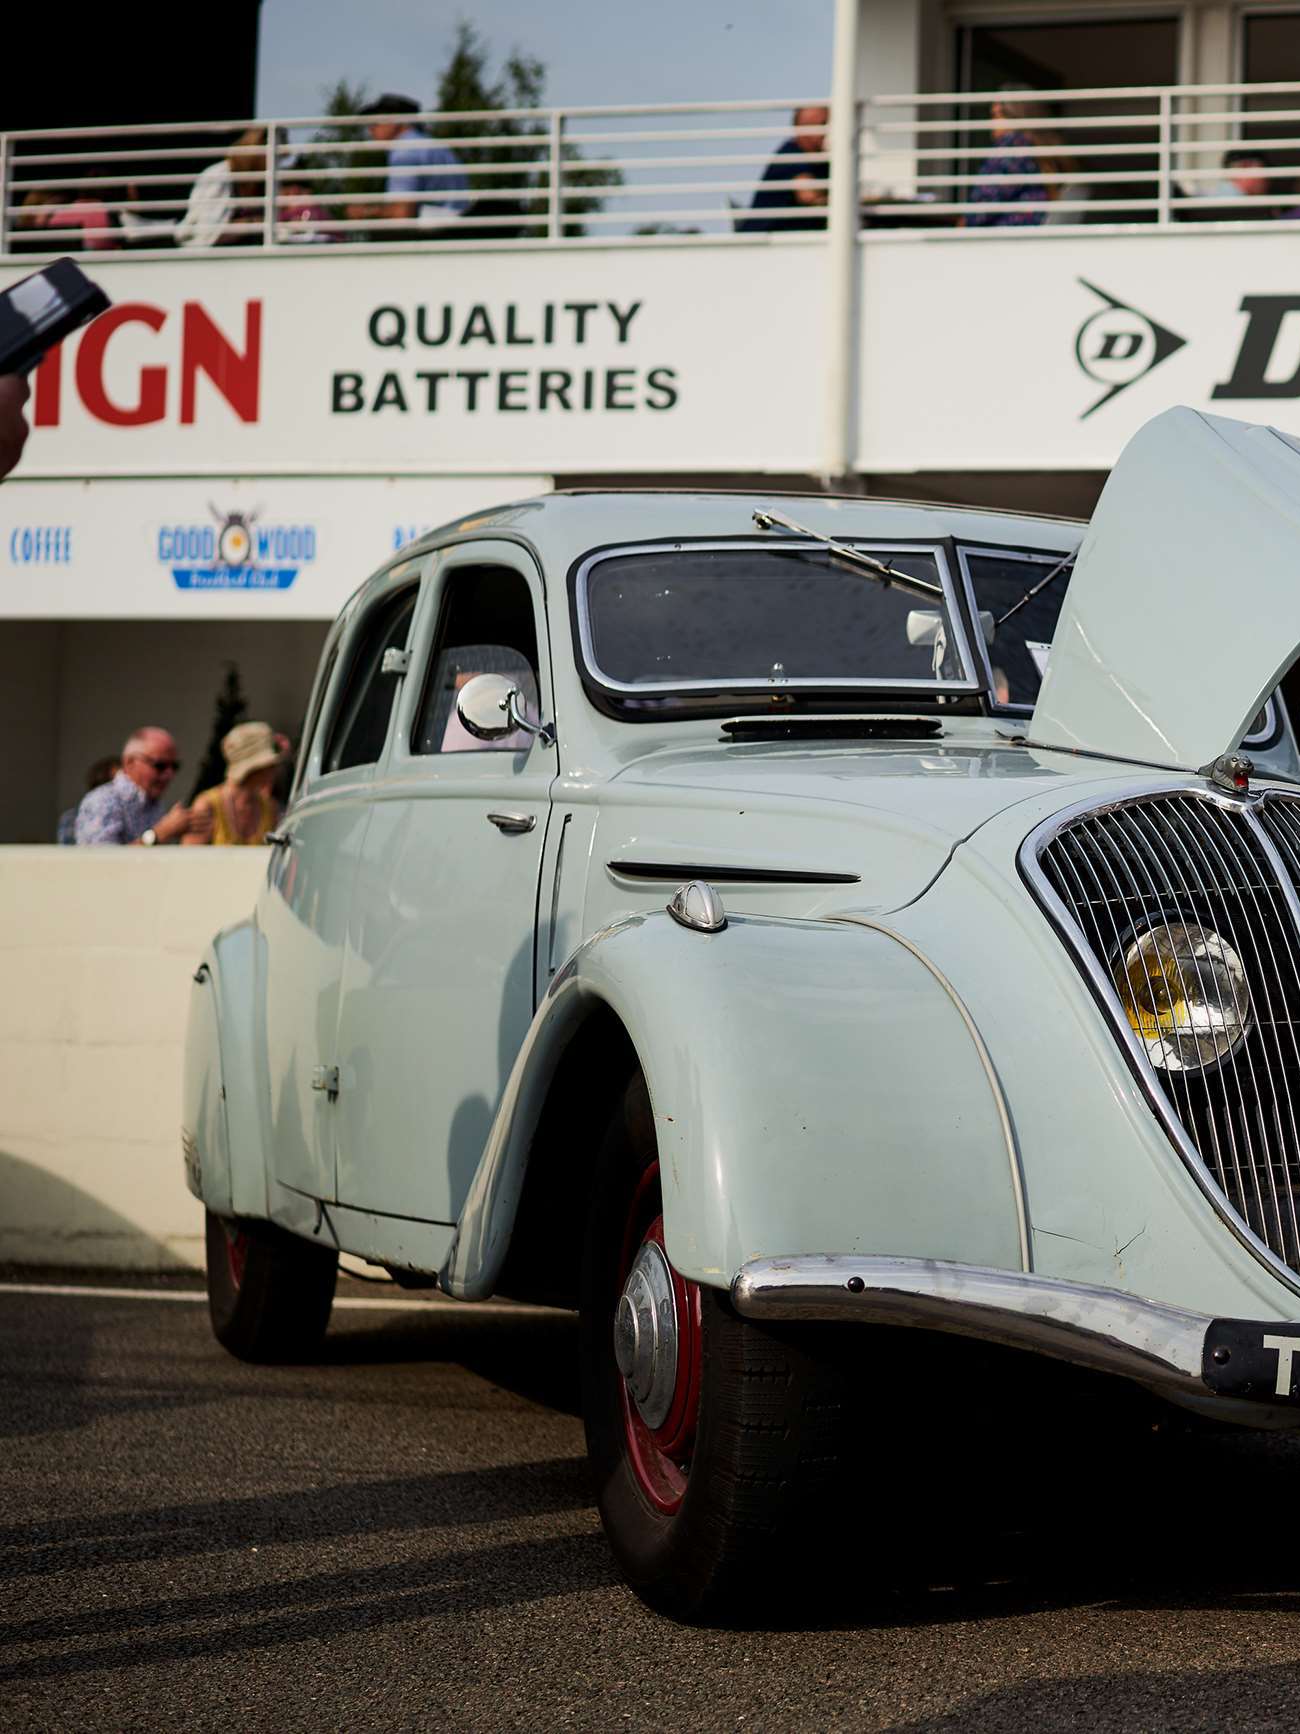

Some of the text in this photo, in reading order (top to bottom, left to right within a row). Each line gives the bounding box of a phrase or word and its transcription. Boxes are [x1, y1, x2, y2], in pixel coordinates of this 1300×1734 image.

[367, 300, 643, 349] QUALITY
[1093, 333, 1144, 361] D
[331, 367, 679, 415] BATTERIES
[10, 527, 72, 563] COFFEE
